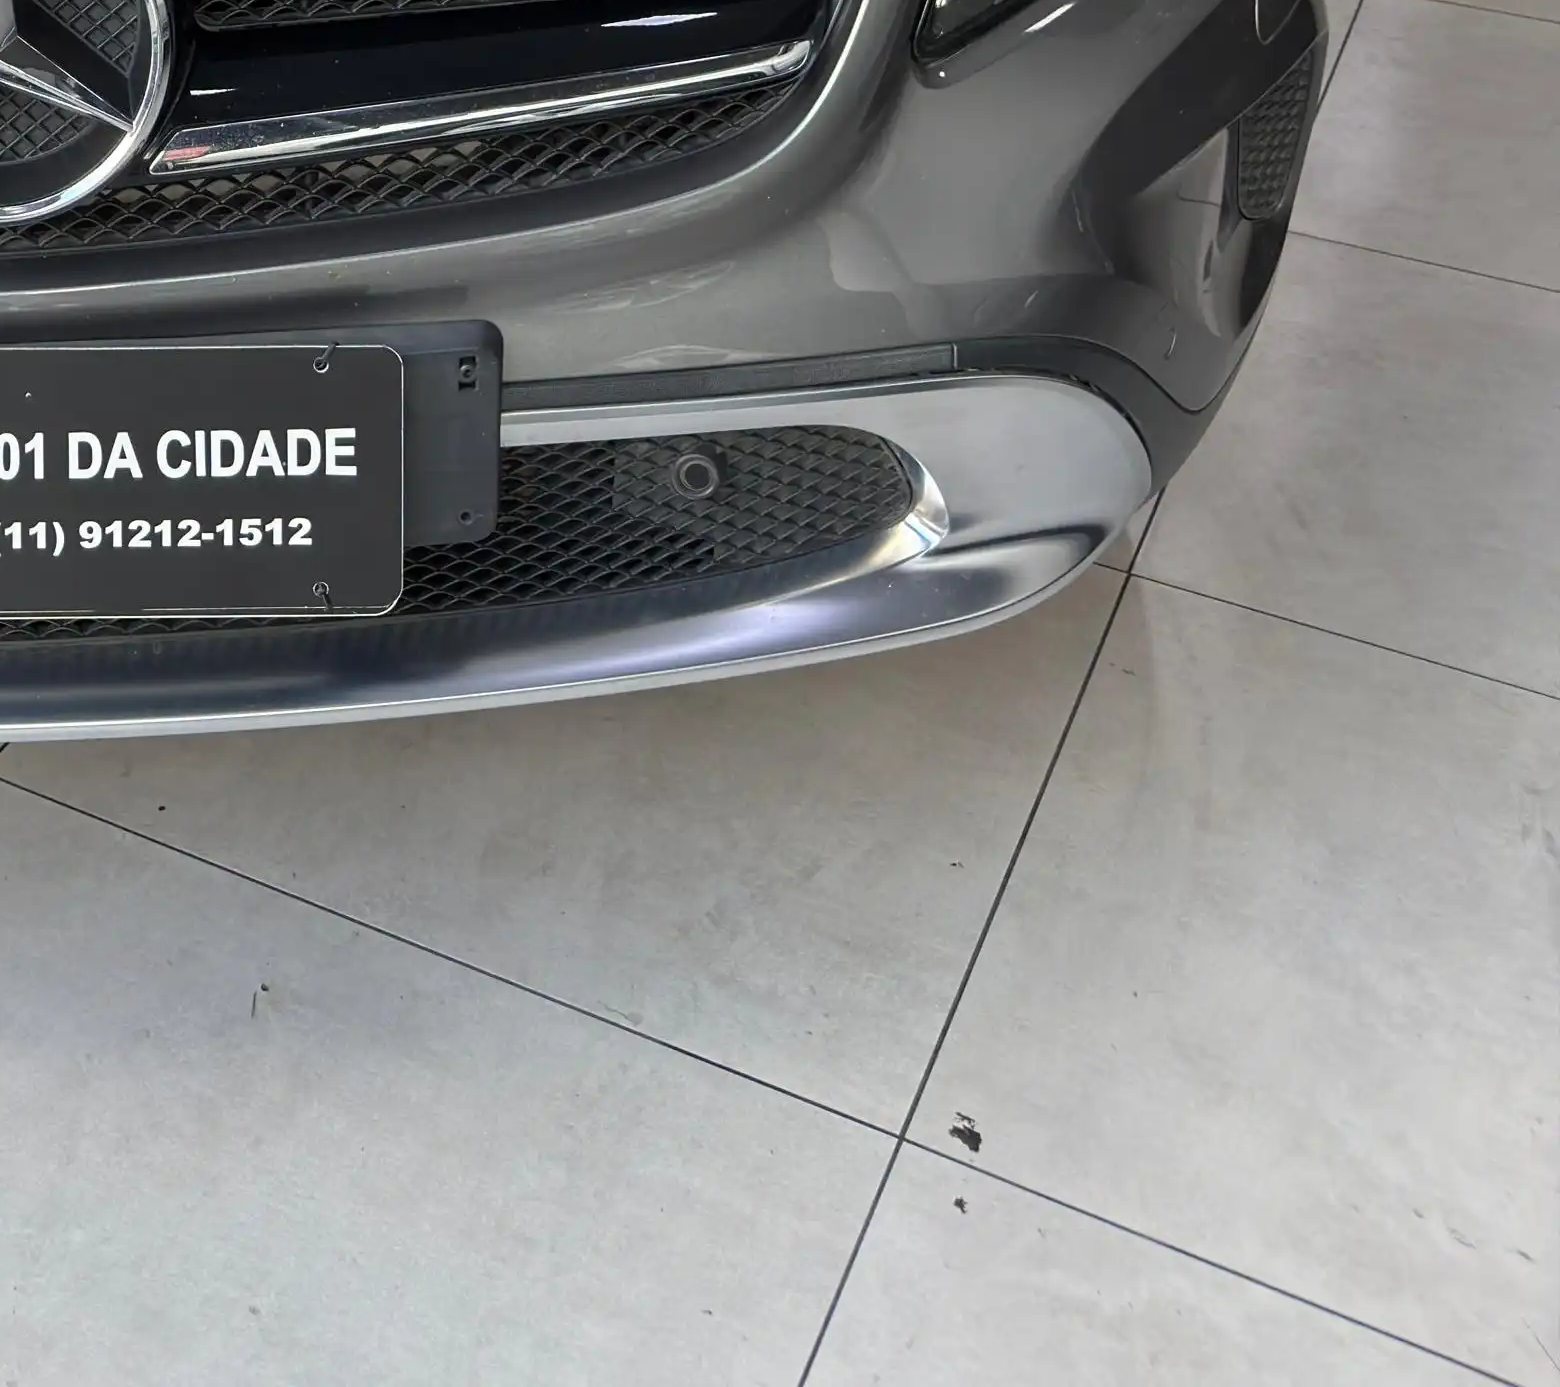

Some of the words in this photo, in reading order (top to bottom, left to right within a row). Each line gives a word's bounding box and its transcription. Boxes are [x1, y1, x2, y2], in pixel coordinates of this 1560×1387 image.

[68, 431, 143, 480] DA
[156, 428, 358, 479] CIDADE
[79, 517, 313, 549] 91212-1512
